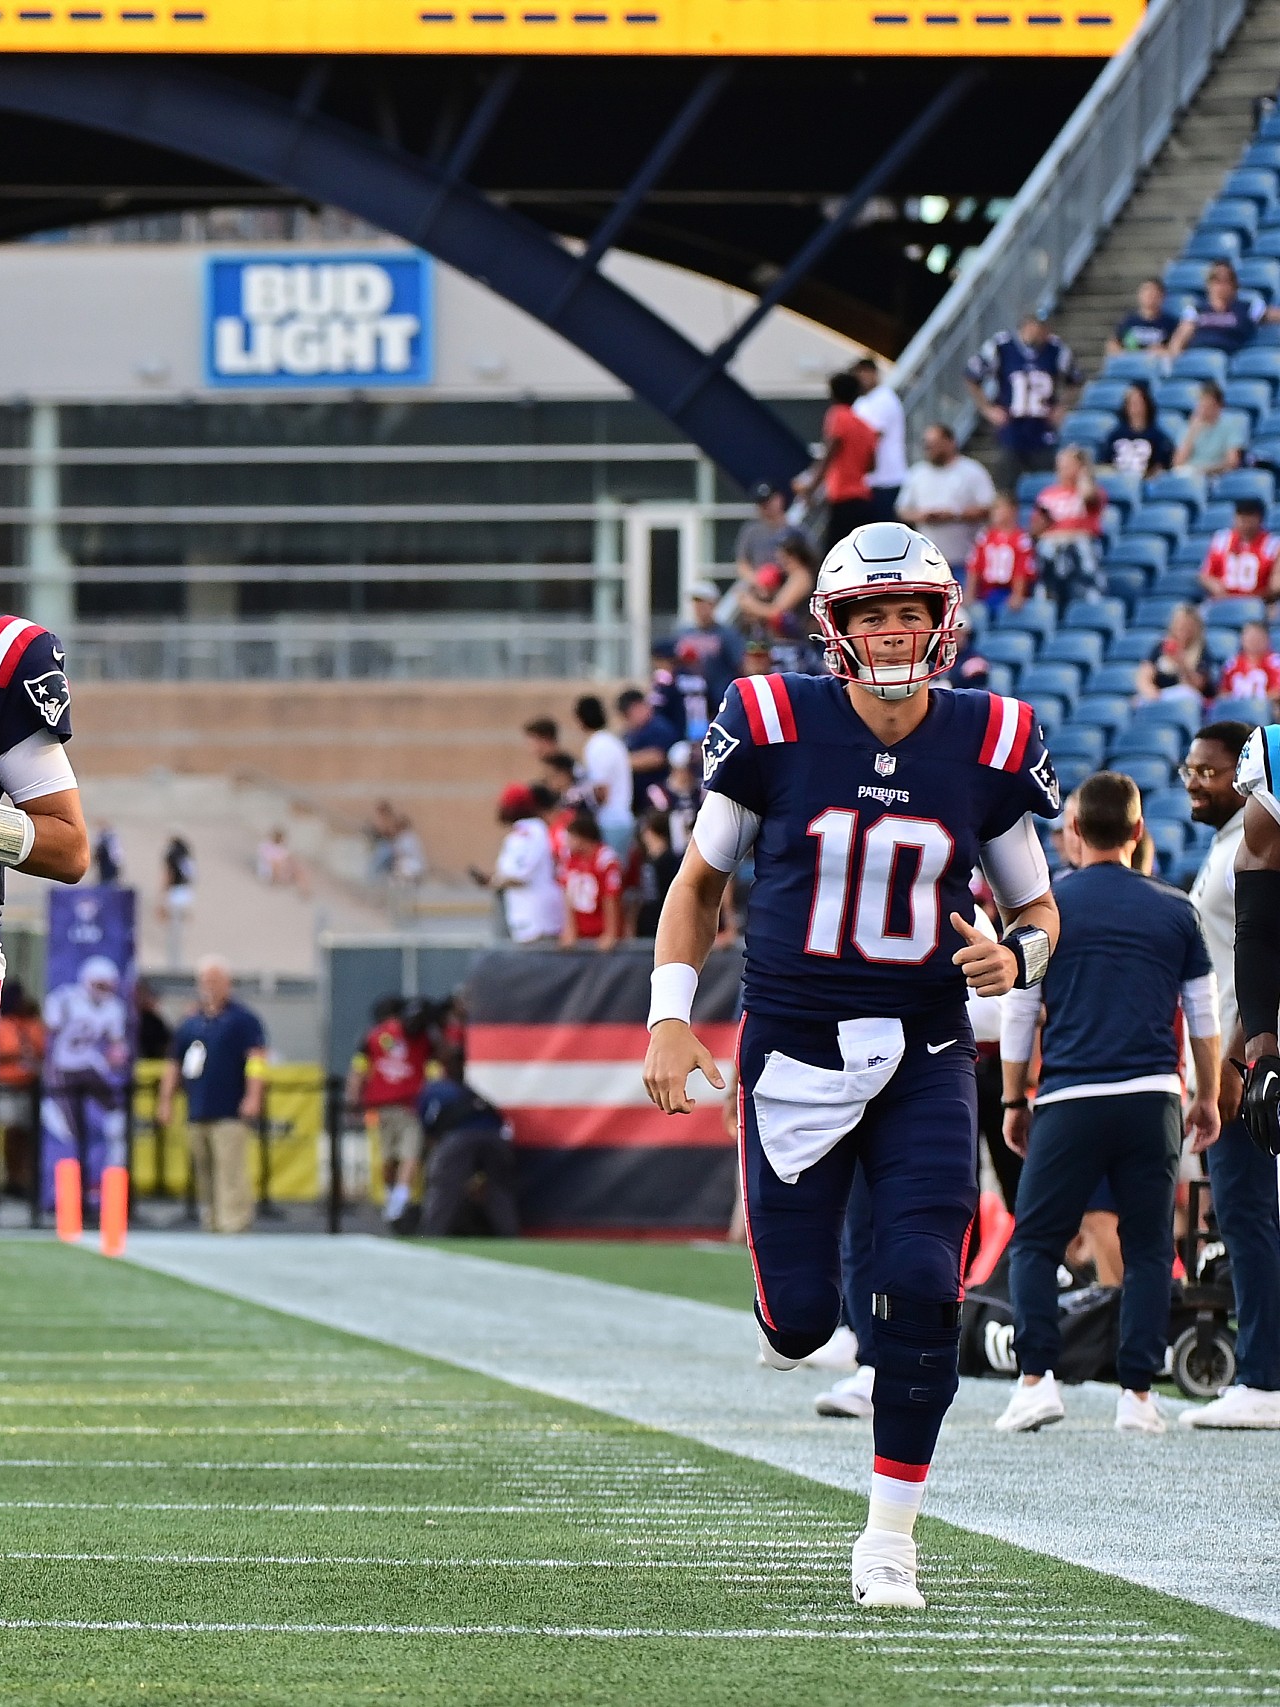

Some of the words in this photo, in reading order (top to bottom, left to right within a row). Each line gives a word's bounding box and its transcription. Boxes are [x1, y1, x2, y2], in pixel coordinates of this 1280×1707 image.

[242, 264, 393, 316] BUD
[216, 314, 420, 375] LIGHT
[1009, 370, 1054, 418] 12
[866, 572, 903, 583] PATRIOTS
[857, 785, 910, 803] PATRIOTS
[803, 806, 956, 966] 10
